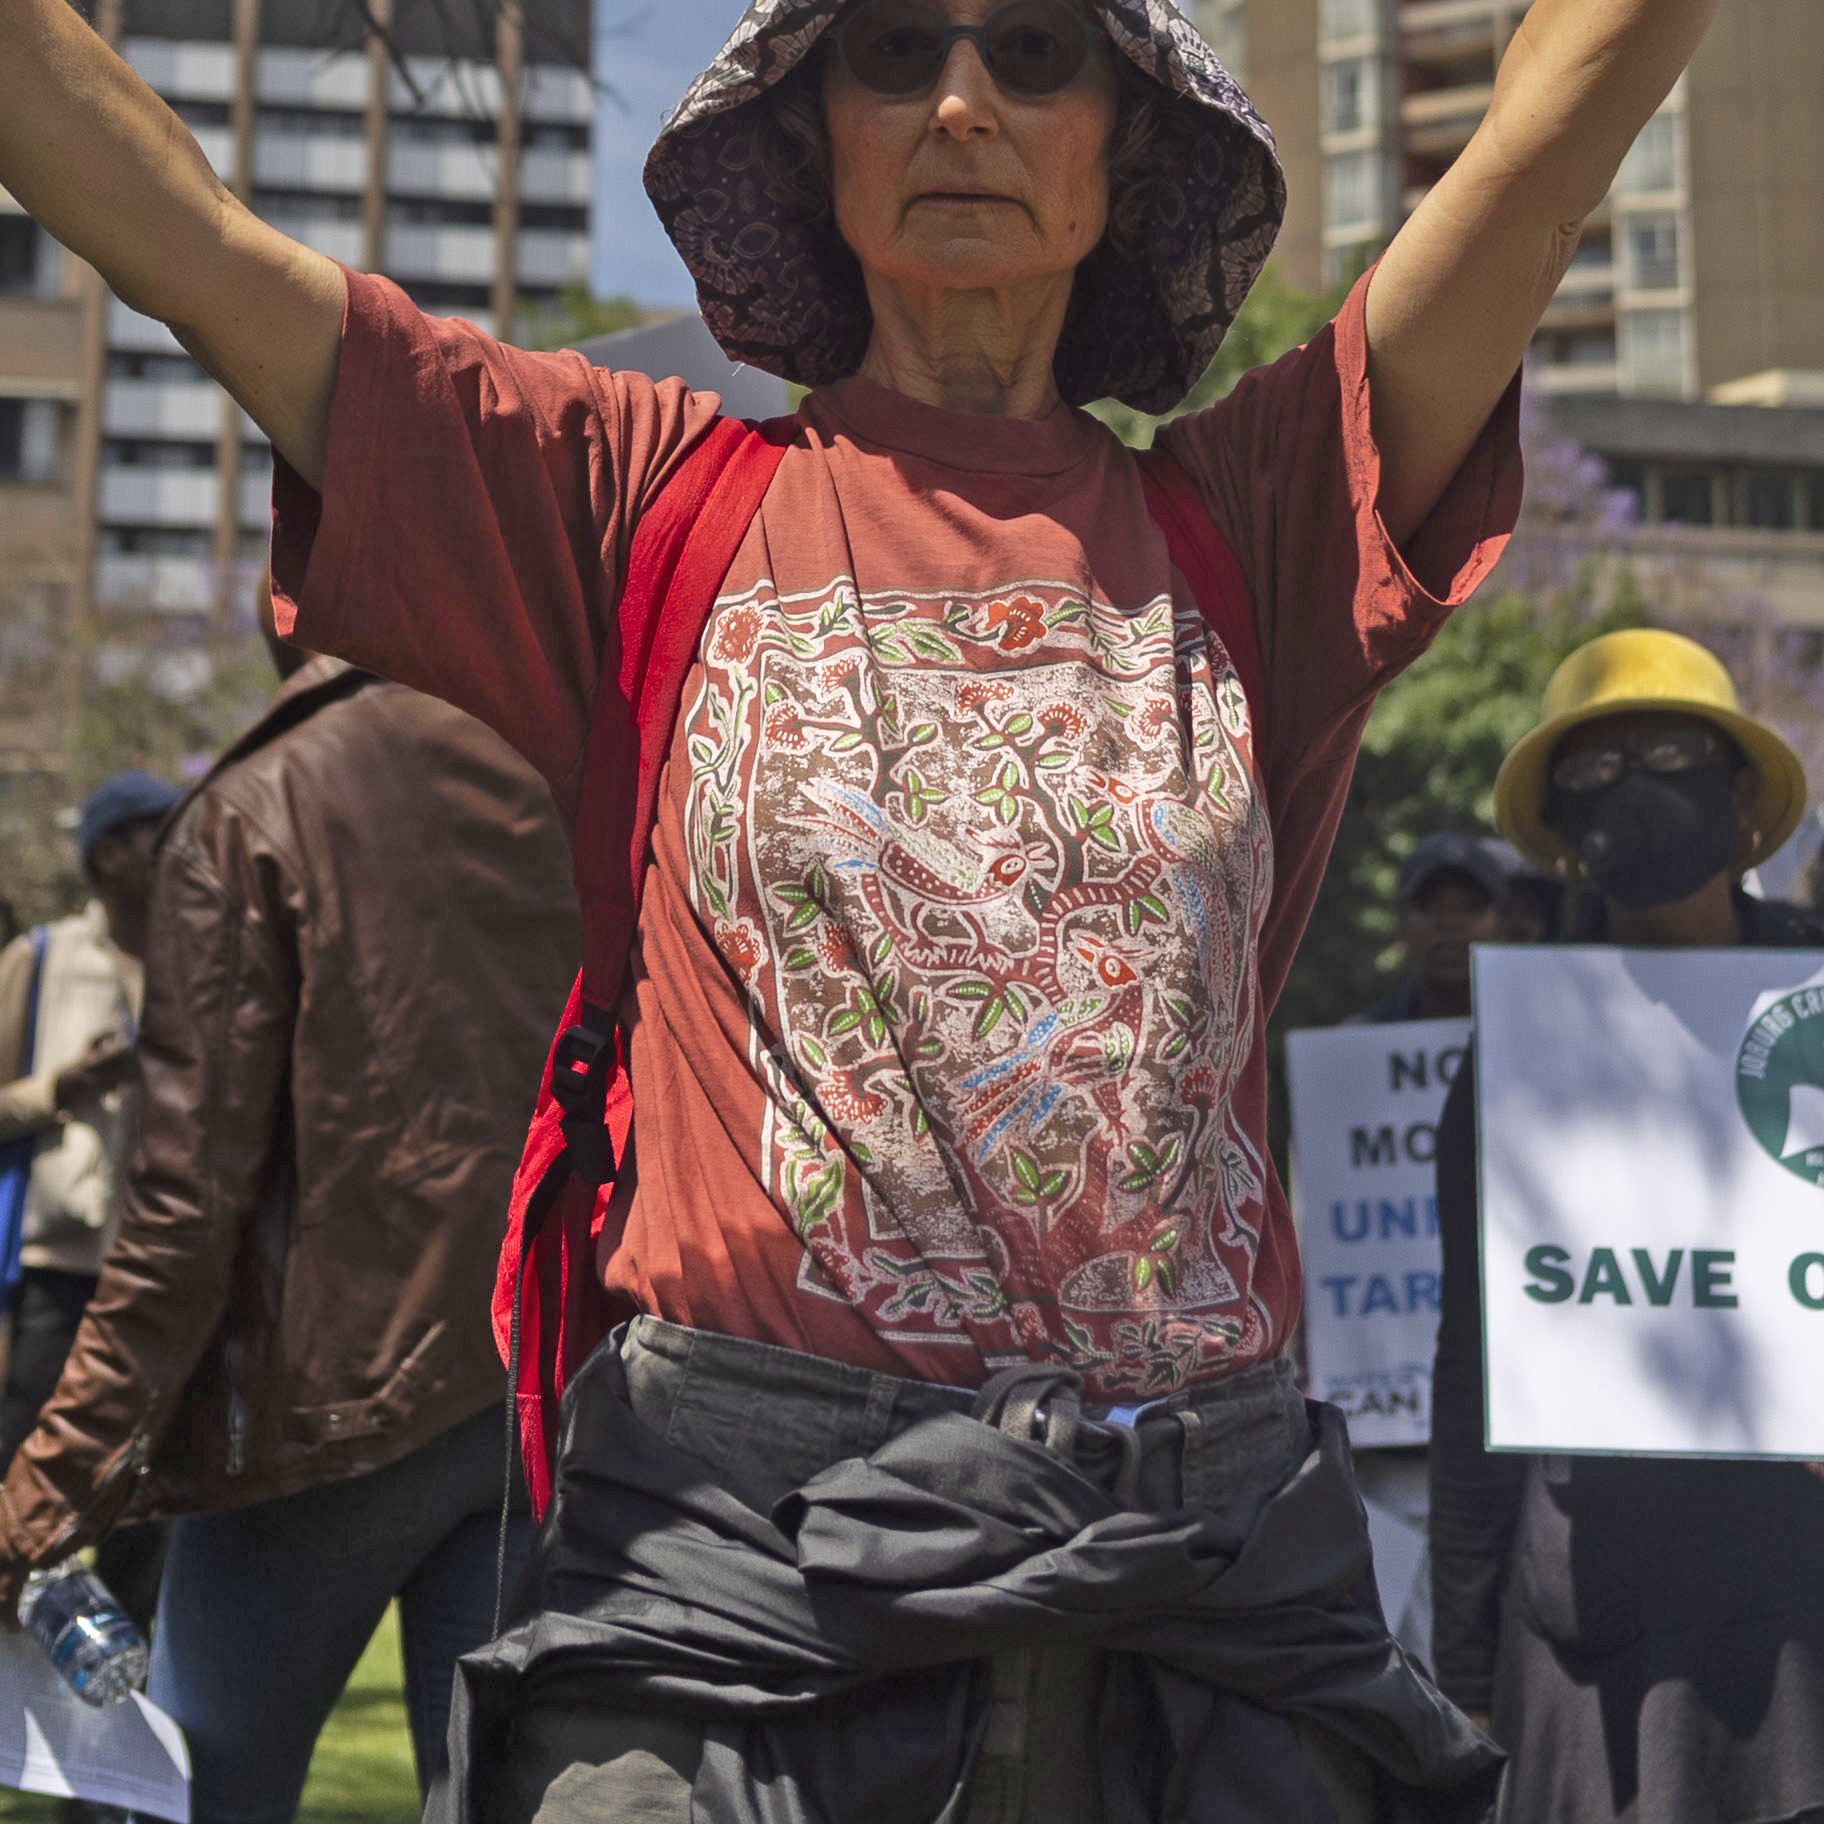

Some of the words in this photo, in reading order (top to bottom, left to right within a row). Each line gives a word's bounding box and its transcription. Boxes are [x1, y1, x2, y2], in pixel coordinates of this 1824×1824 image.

[1738, 1004, 1796, 1080] JOBURG
[1349, 1123, 1438, 1170] MO
[1322, 1269, 1442, 1319] TAR
[1521, 1243, 1740, 1309] SAVE
